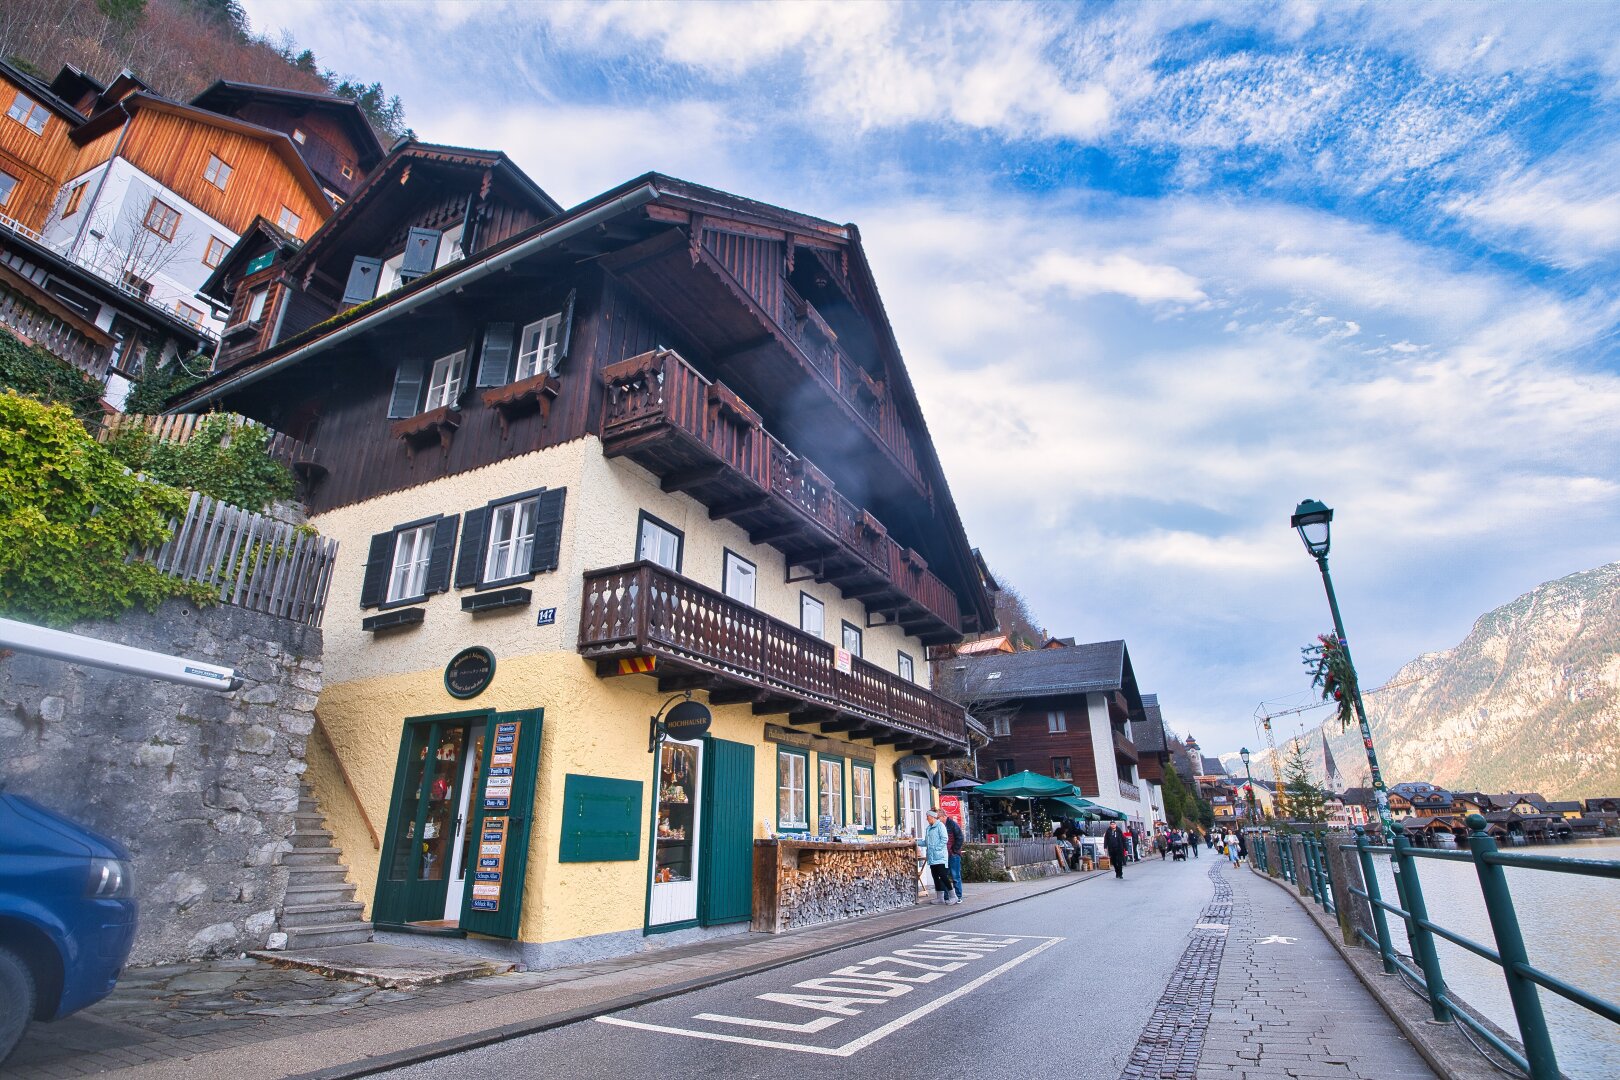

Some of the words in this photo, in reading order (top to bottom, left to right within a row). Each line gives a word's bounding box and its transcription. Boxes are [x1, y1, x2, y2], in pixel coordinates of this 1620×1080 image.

[539, 609, 554, 620] 147
[668, 717, 708, 728] HOCHHAUSER
[691, 934, 1022, 1033] LADEZONE
